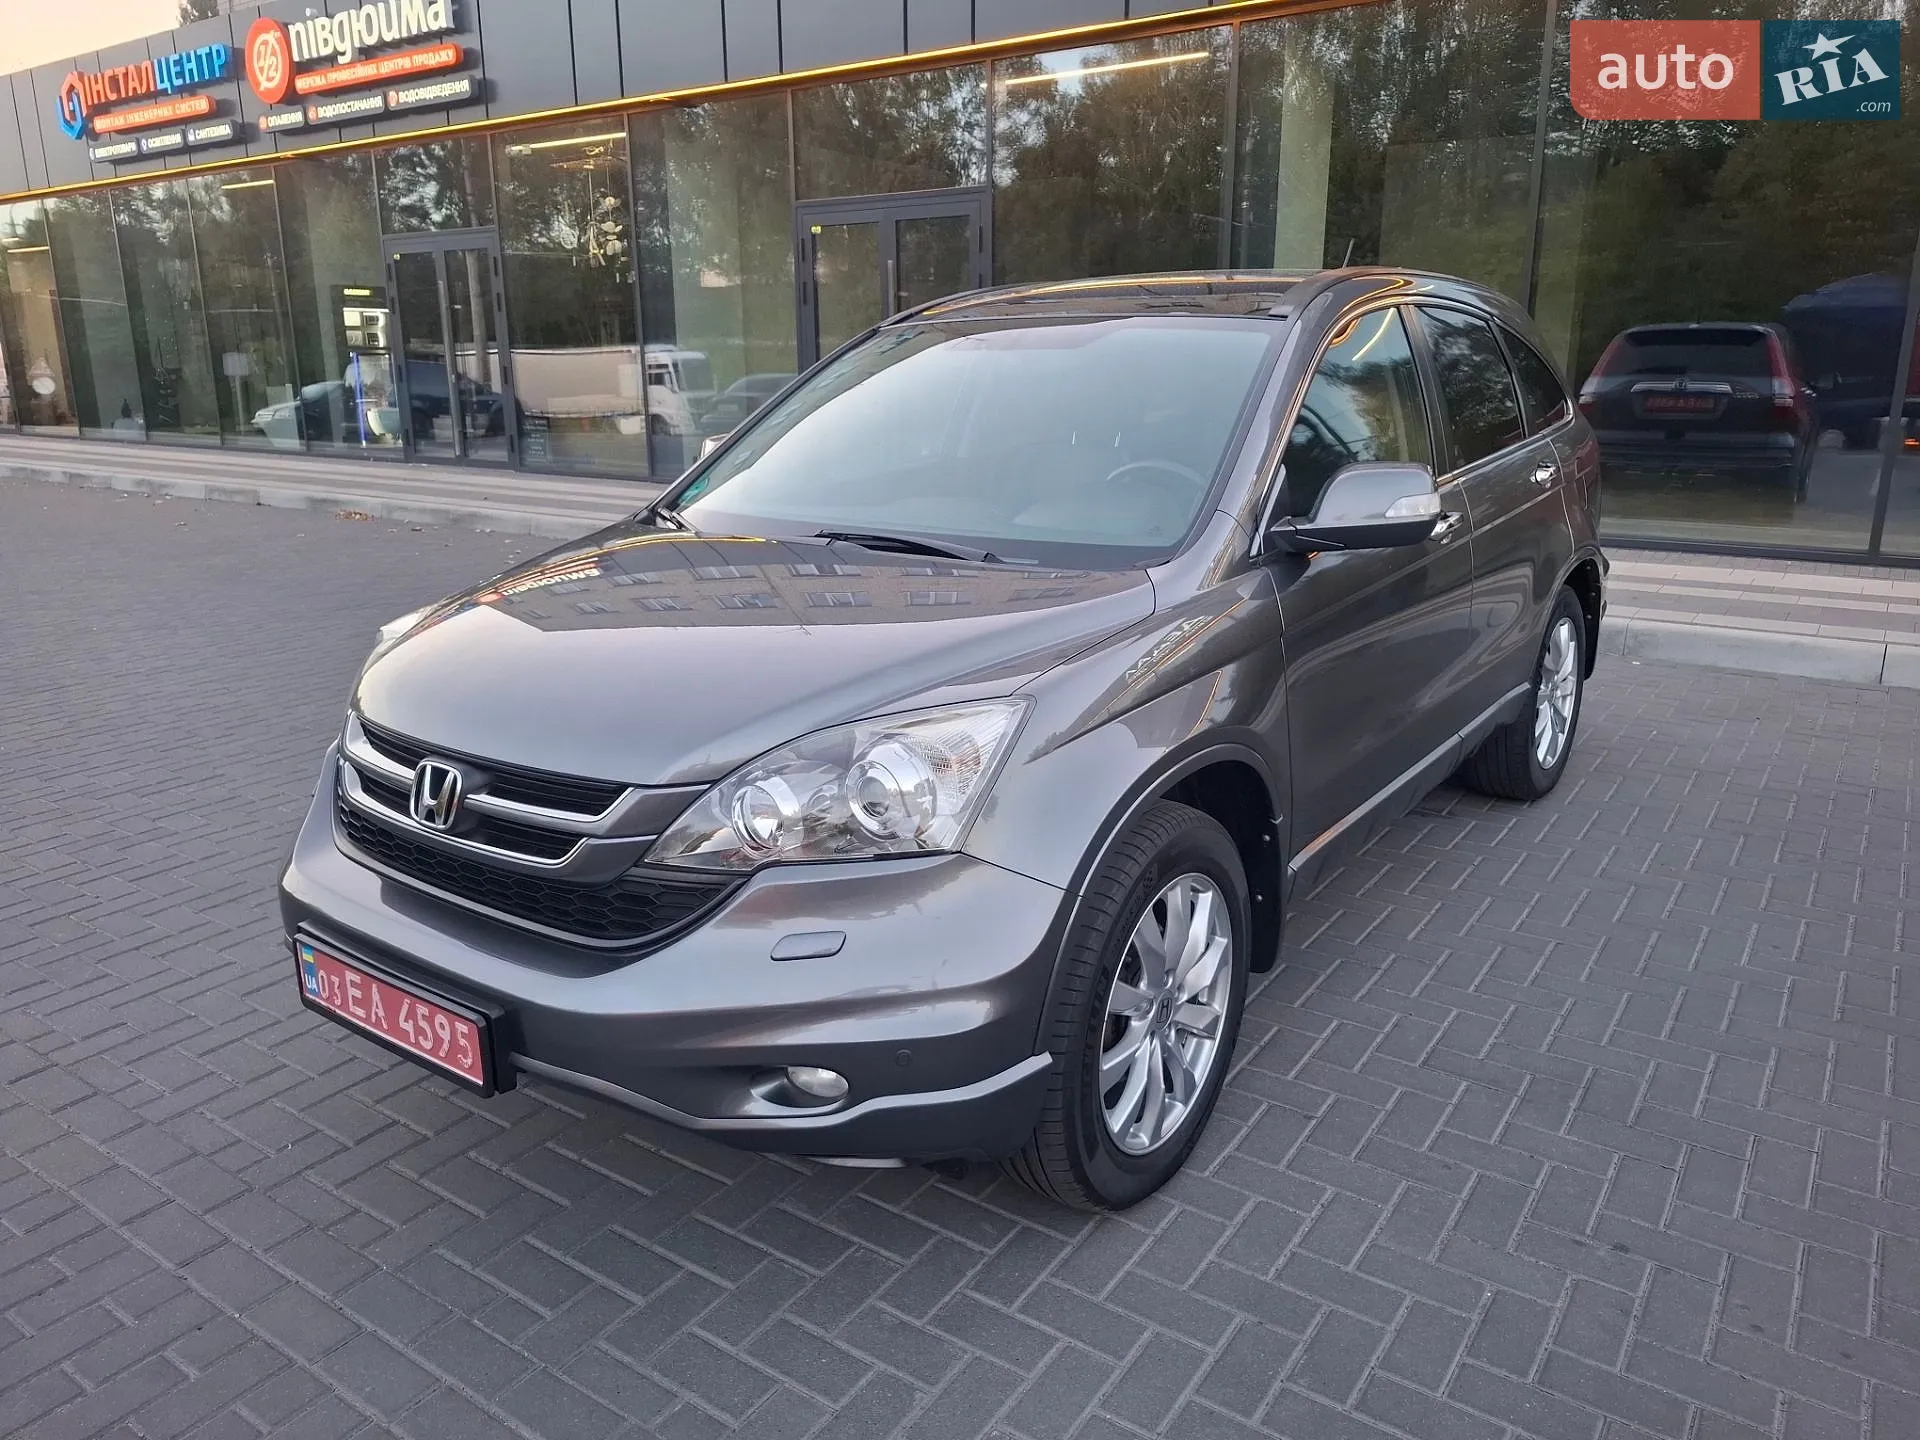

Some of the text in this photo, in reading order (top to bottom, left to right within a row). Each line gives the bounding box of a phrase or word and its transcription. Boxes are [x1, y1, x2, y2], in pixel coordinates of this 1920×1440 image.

[413, 49, 453, 67] ПРОДАЖУ
[84, 43, 228, 106] ІНСТАЛЦЕНТР
[399, 80, 470, 103] ВОДОВІДВЕДЕННЯ
[305, 973, 318, 993] UA
[399, 999, 473, 1069] 4595
